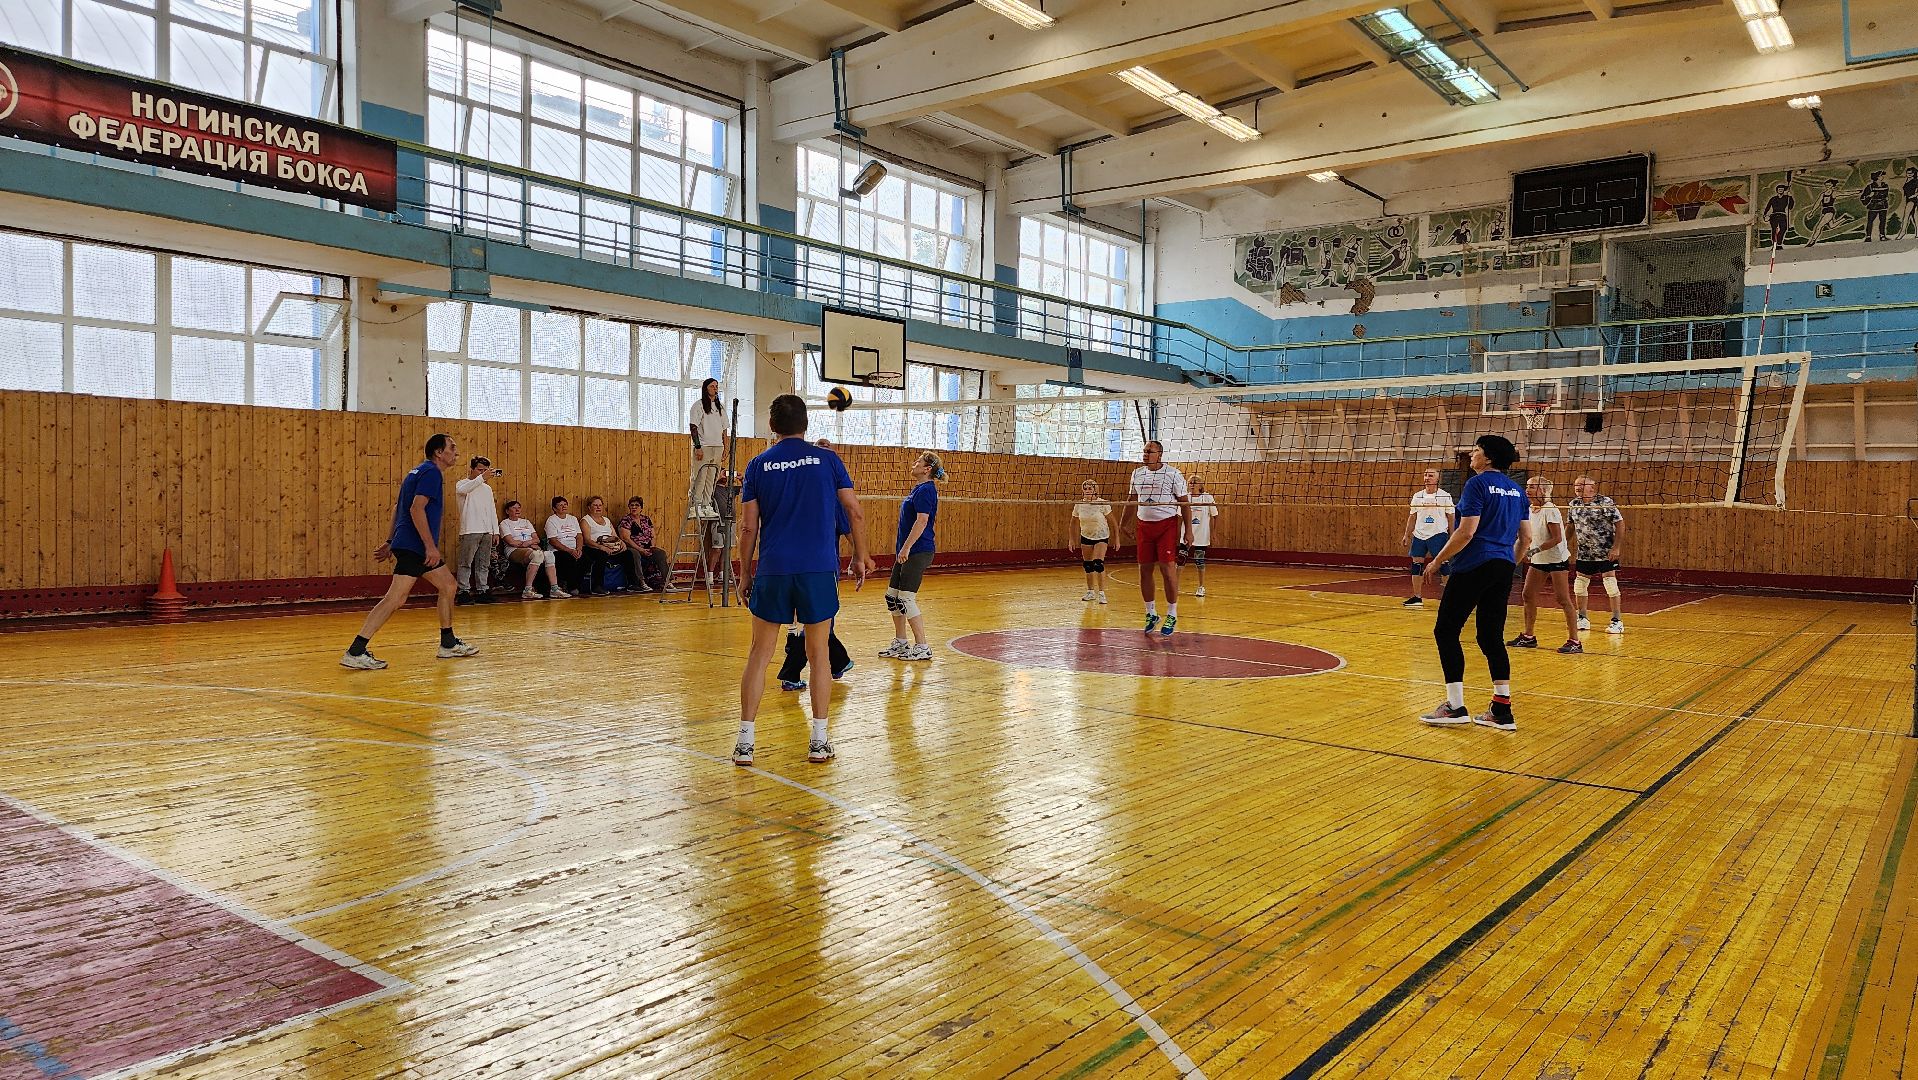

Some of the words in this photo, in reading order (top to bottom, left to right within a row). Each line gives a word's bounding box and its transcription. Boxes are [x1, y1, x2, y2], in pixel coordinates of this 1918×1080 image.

[68, 112, 269, 175] ФЕДЕРАЦИЯ
[276, 154, 369, 196] БОКСА
[132, 91, 321, 155] НОГИНСКАЯ
[763, 455, 820, 471] Королёв
